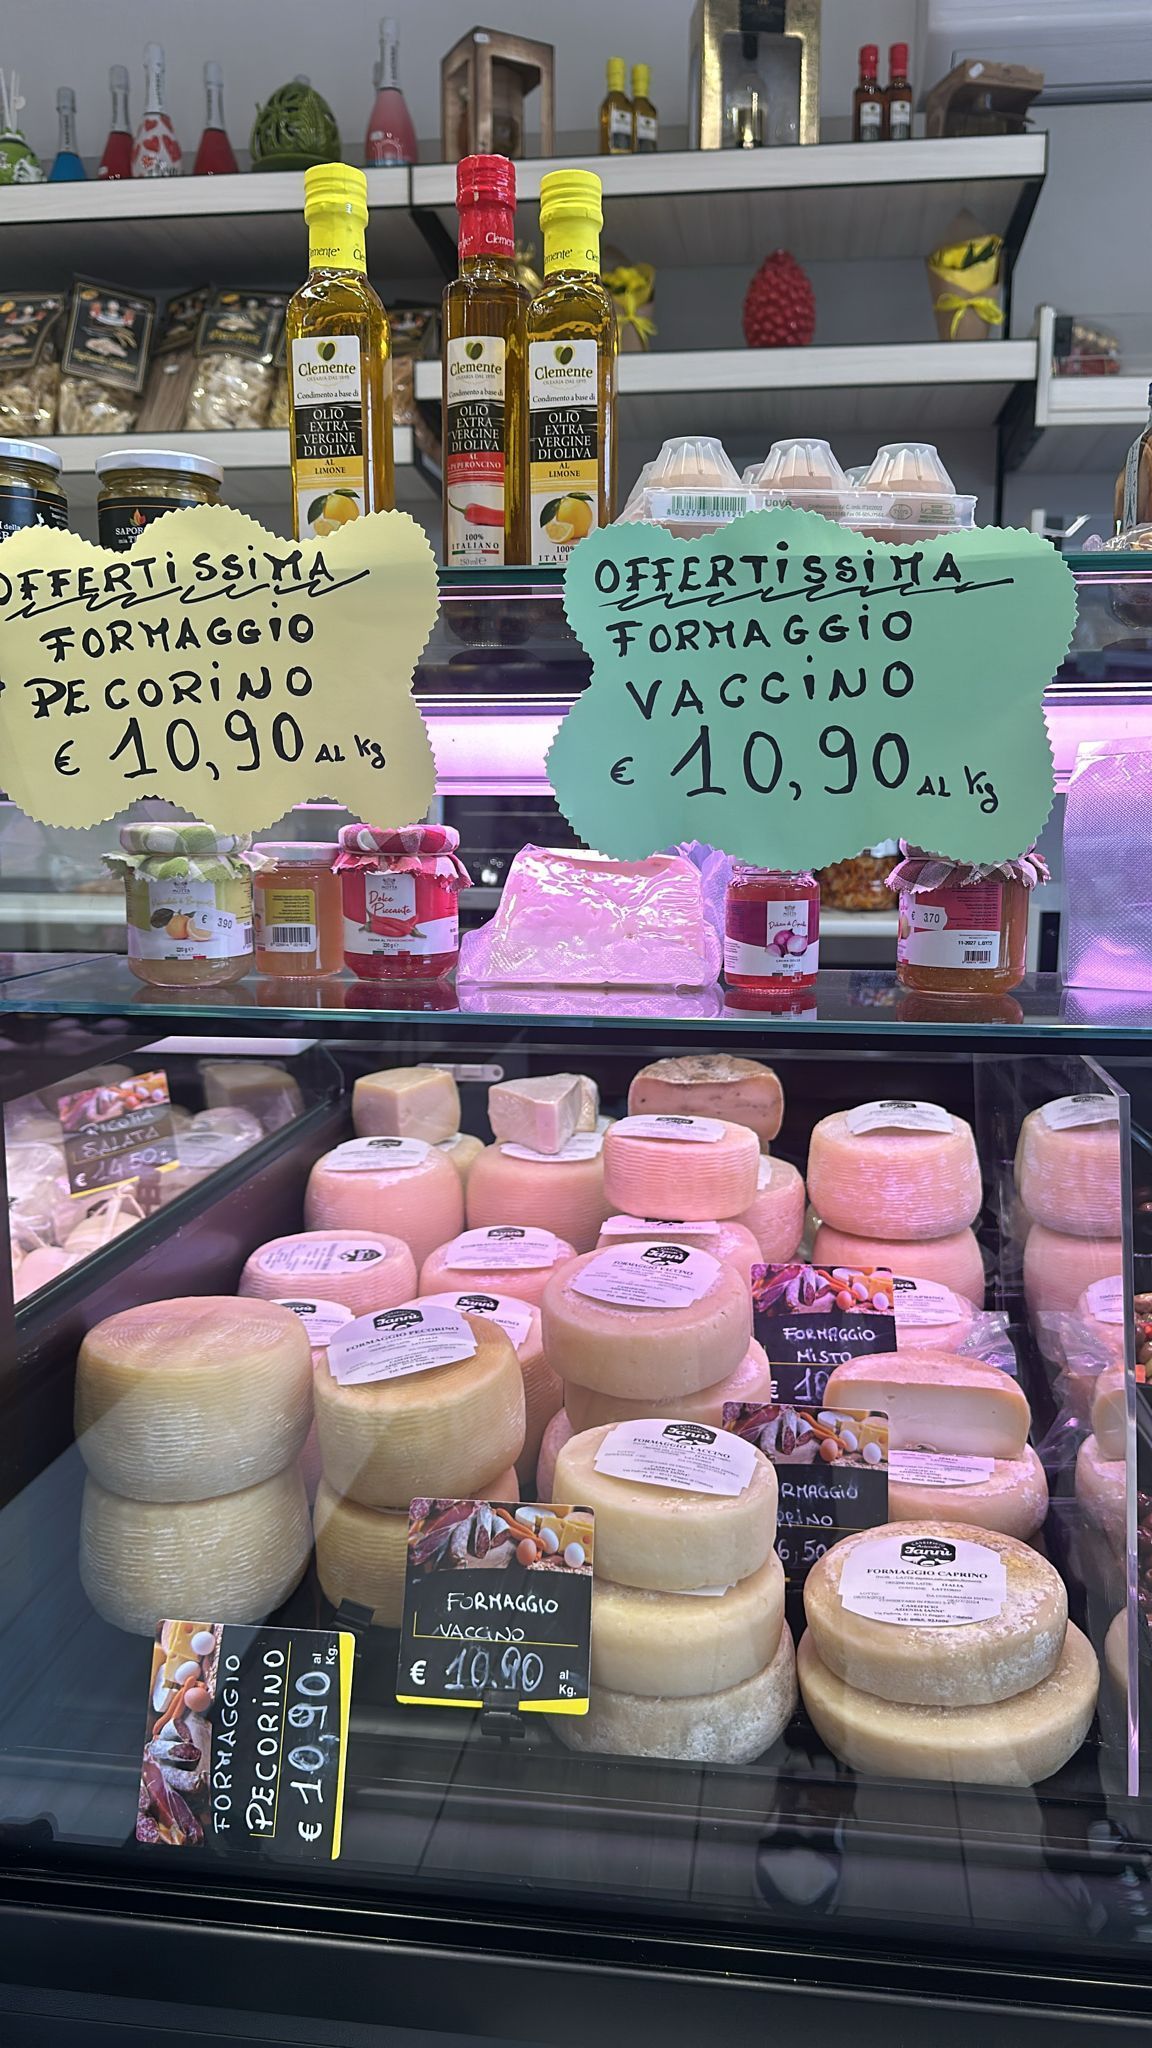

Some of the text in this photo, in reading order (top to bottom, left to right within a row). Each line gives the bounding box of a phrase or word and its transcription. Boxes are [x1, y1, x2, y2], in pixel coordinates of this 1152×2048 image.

[298, 362, 356, 377] Clemente
[450, 362, 502, 376] Clemente
[534, 366, 593, 380] Clemente
[297, 391, 333, 400] Condimento
[339, 389, 351, 397] base
[353, 389, 359, 397] di
[449, 388, 480, 399] Condimento
[484, 388, 496, 396] base
[497, 388, 504, 396] di
[532, 394, 569, 403] Condimento
[575, 393, 588, 401] base
[313, 408, 344, 420] OLIO
[460, 405, 489, 416] OLIO
[457, 418, 493, 429] EXTRA
[549, 412, 579, 423] OLIO
[310, 421, 349, 433] EXTRA
[545, 424, 584, 436] EXTRA
[303, 432, 356, 444] VERGINE
[452, 428, 500, 440] VERGINE
[452, 440, 500, 452] DI OLIVA
[538, 436, 591, 447] VERGINE
[304, 445, 357, 456] DI OLIVA
[538, 448, 592, 460] DI OLIVA
[315, 466, 346, 474] LIMONE
[450, 461, 502, 470] PEPERONCINO
[548, 470, 581, 478] LIMONE
[465, 533, 484, 541] 100%
[452, 542, 499, 550] ITALIANO
[54, 740, 80, 775] €
[109, 709, 305, 780] 10,90
[315, 744, 345, 762] AL
[610, 756, 635, 785] €
[670, 725, 909, 800] 10,90
[916, 776, 951, 797] AL
[369, 891, 393, 904] Dolce
[371, 902, 411, 915] Piccante
[202, 914, 208, 924] €
[912, 911, 940, 923] € 370
[83, 1126, 160, 1157] SALATA
[75, 1173, 87, 1187] €
[346, 1326, 459, 1352] FORMAGGIO PECORINO
[633, 1438, 730, 1458] FORMAGGIO VACCINO
[867, 1568, 988, 1579] FORMAGGIO CAPRINO
[447, 1592, 558, 1614] FORMAGGIO
[312, 1653, 321, 1664] al
[325, 1644, 338, 1665] Kg.
[410, 1660, 427, 1685] €
[559, 1670, 569, 1680] al
[559, 1684, 577, 1697] Kg.
[213, 1655, 241, 1834] FORMAGGIO
[298, 1821, 322, 1842] €
